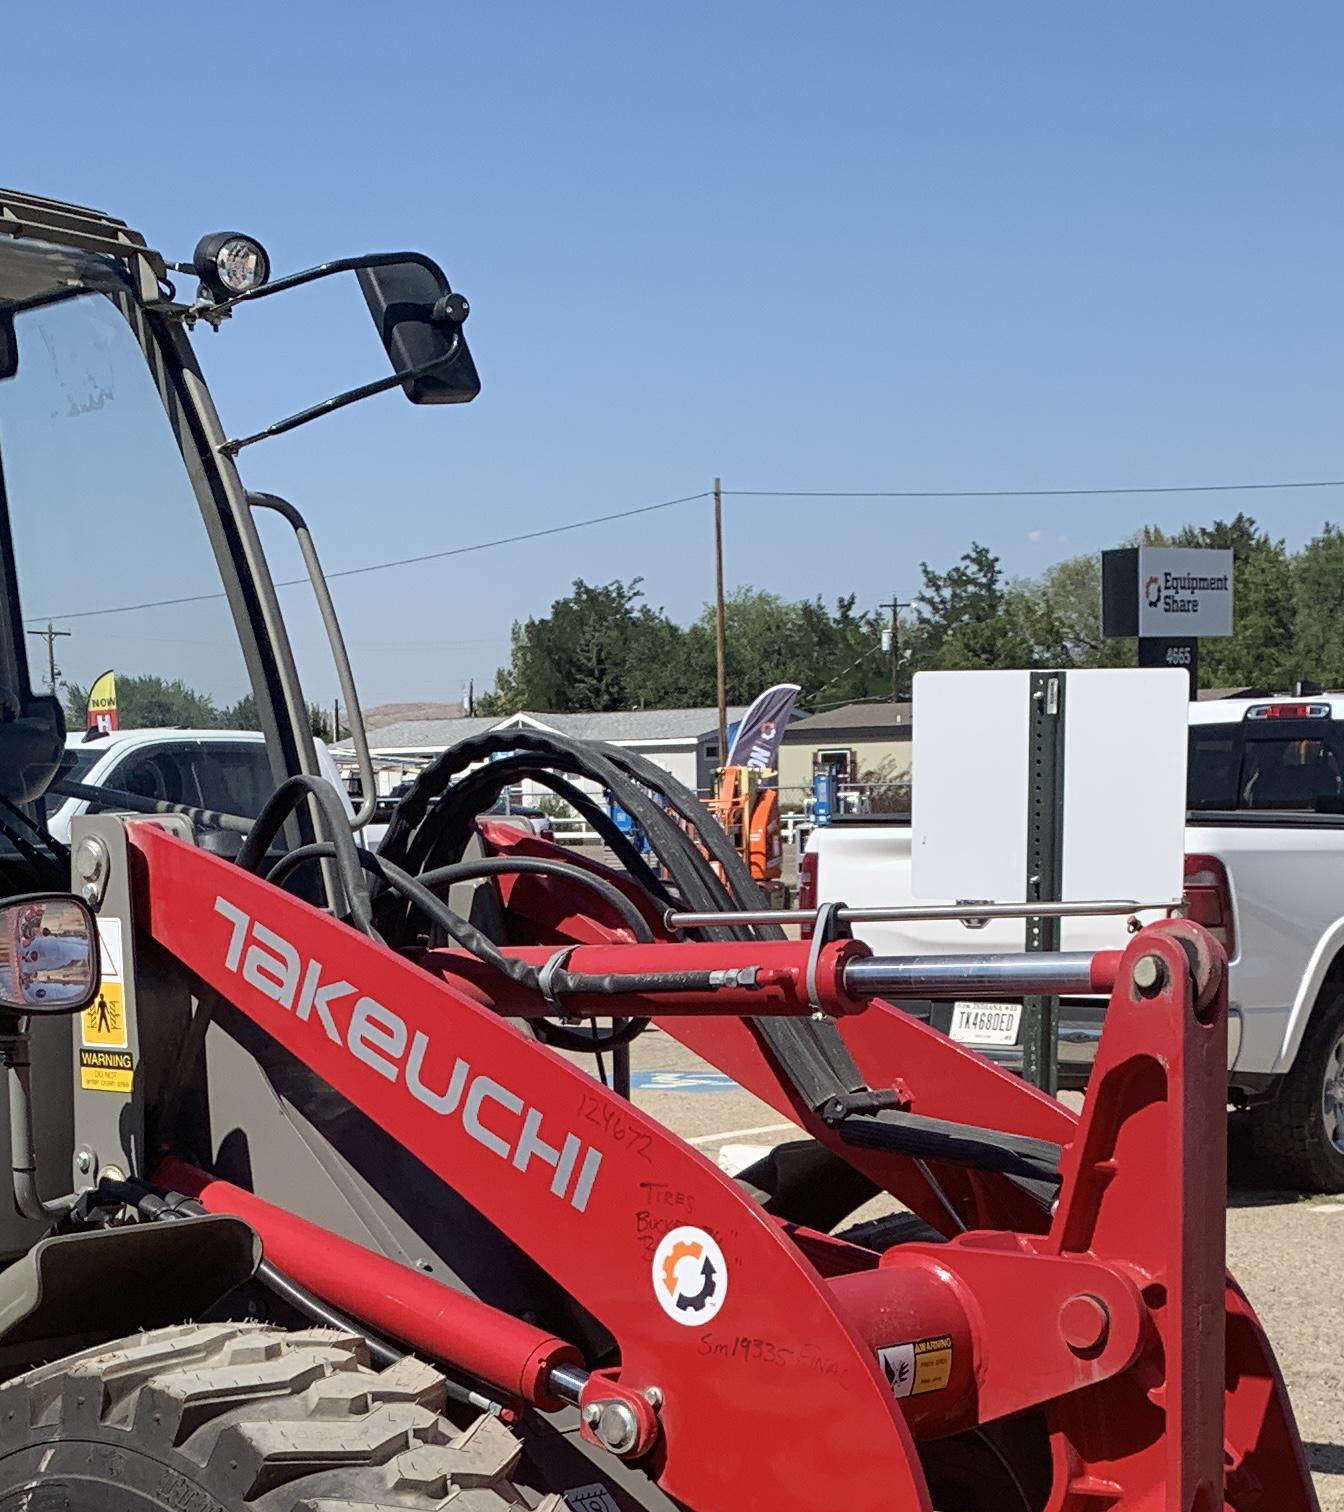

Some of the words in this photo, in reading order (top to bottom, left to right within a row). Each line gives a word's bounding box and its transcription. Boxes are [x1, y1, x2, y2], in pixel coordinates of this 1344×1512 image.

[1163, 572, 1229, 594] Equipment
[1163, 595, 1199, 613] Share
[92, 697, 116, 708] NOW
[81, 1051, 132, 1068] WARNING
[577, 1094, 653, 1164] 124672
[919, 1337, 952, 1353] WARNING
